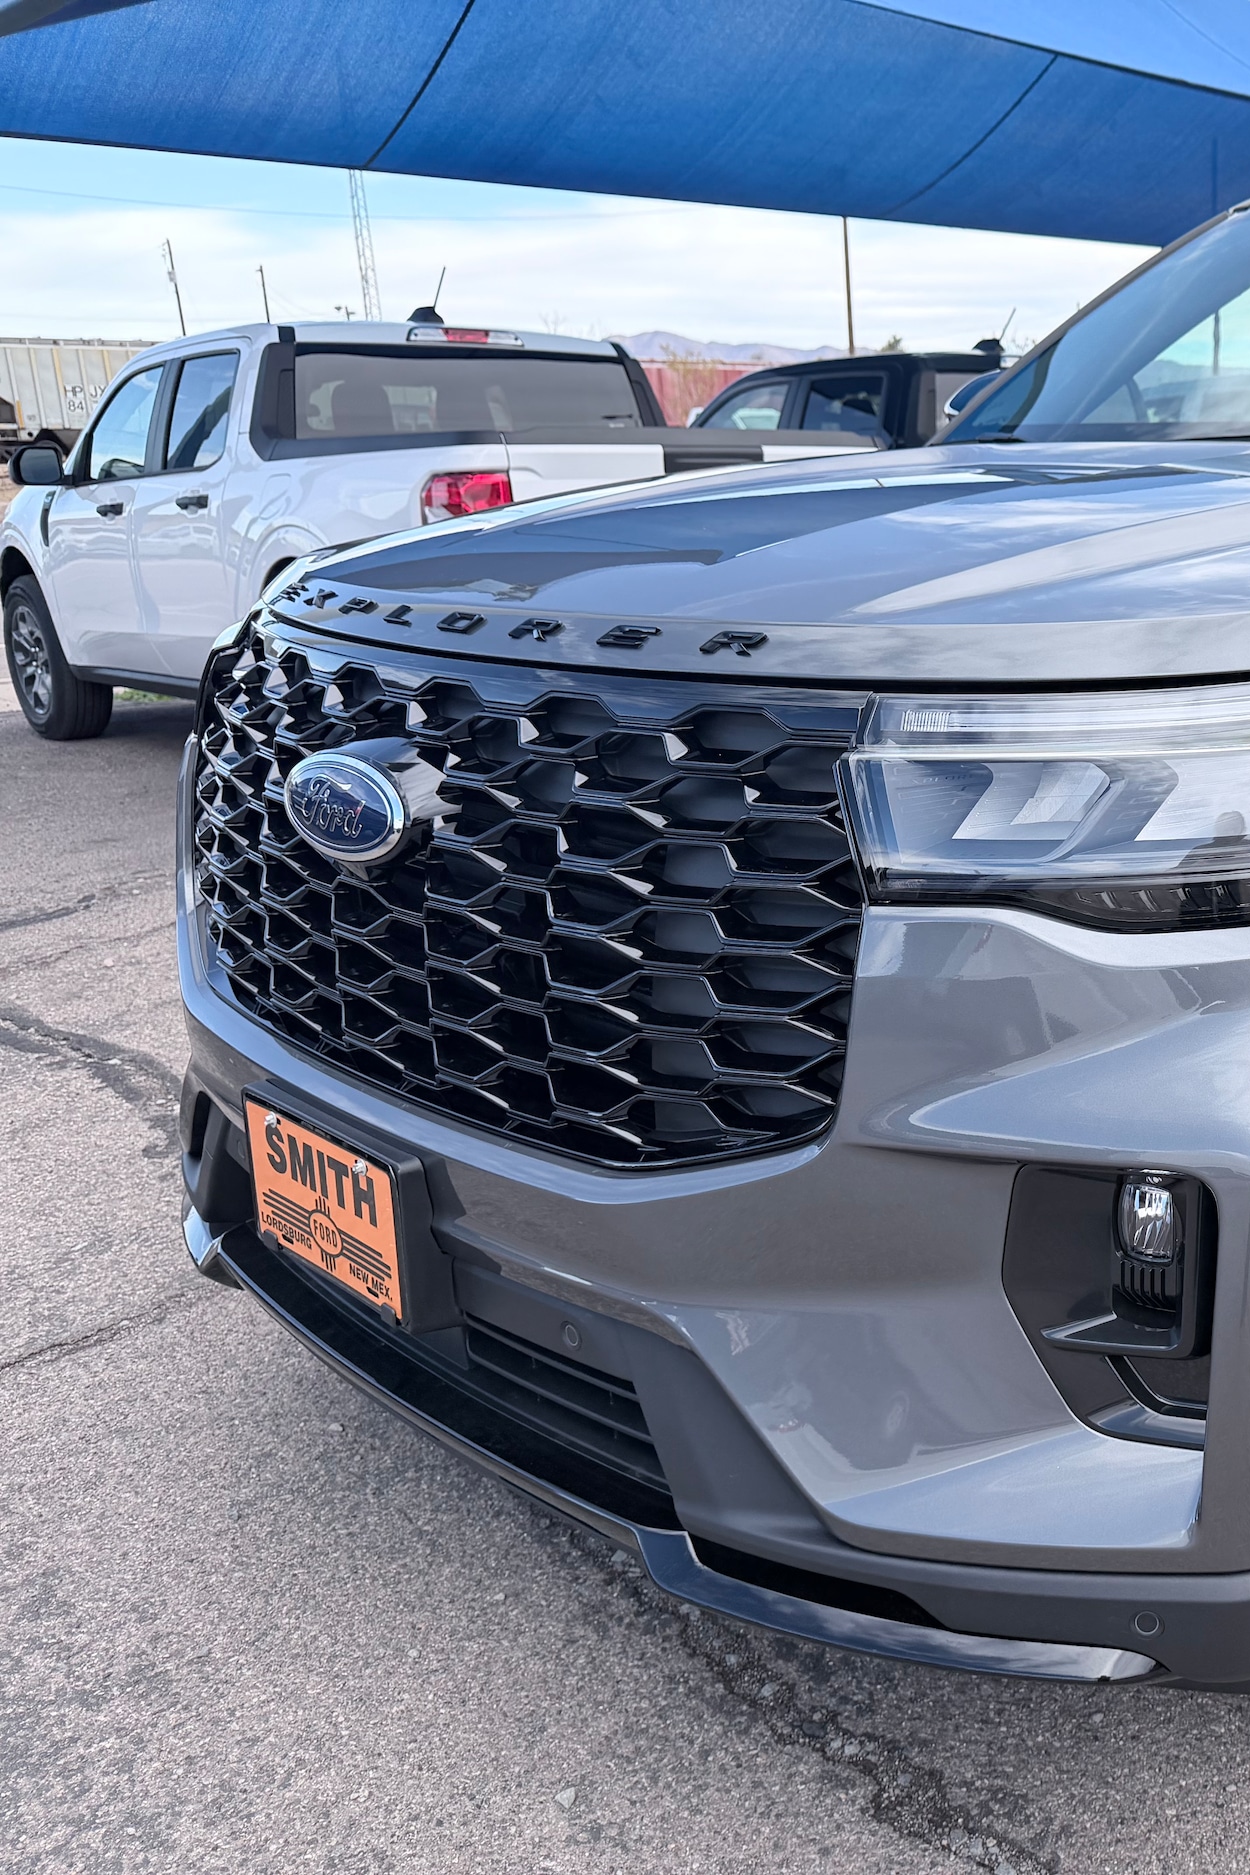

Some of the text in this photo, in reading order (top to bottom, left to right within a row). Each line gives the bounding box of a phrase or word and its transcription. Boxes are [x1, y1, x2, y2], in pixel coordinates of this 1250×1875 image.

[268, 582, 770, 657] EXPLORER
[300, 773, 366, 839] Ford
[265, 1124, 378, 1228] SMITH
[261, 1211, 312, 1250] LORDSBURG
[313, 1219, 338, 1249] FORD
[349, 1263, 393, 1301] NEW MEX.
